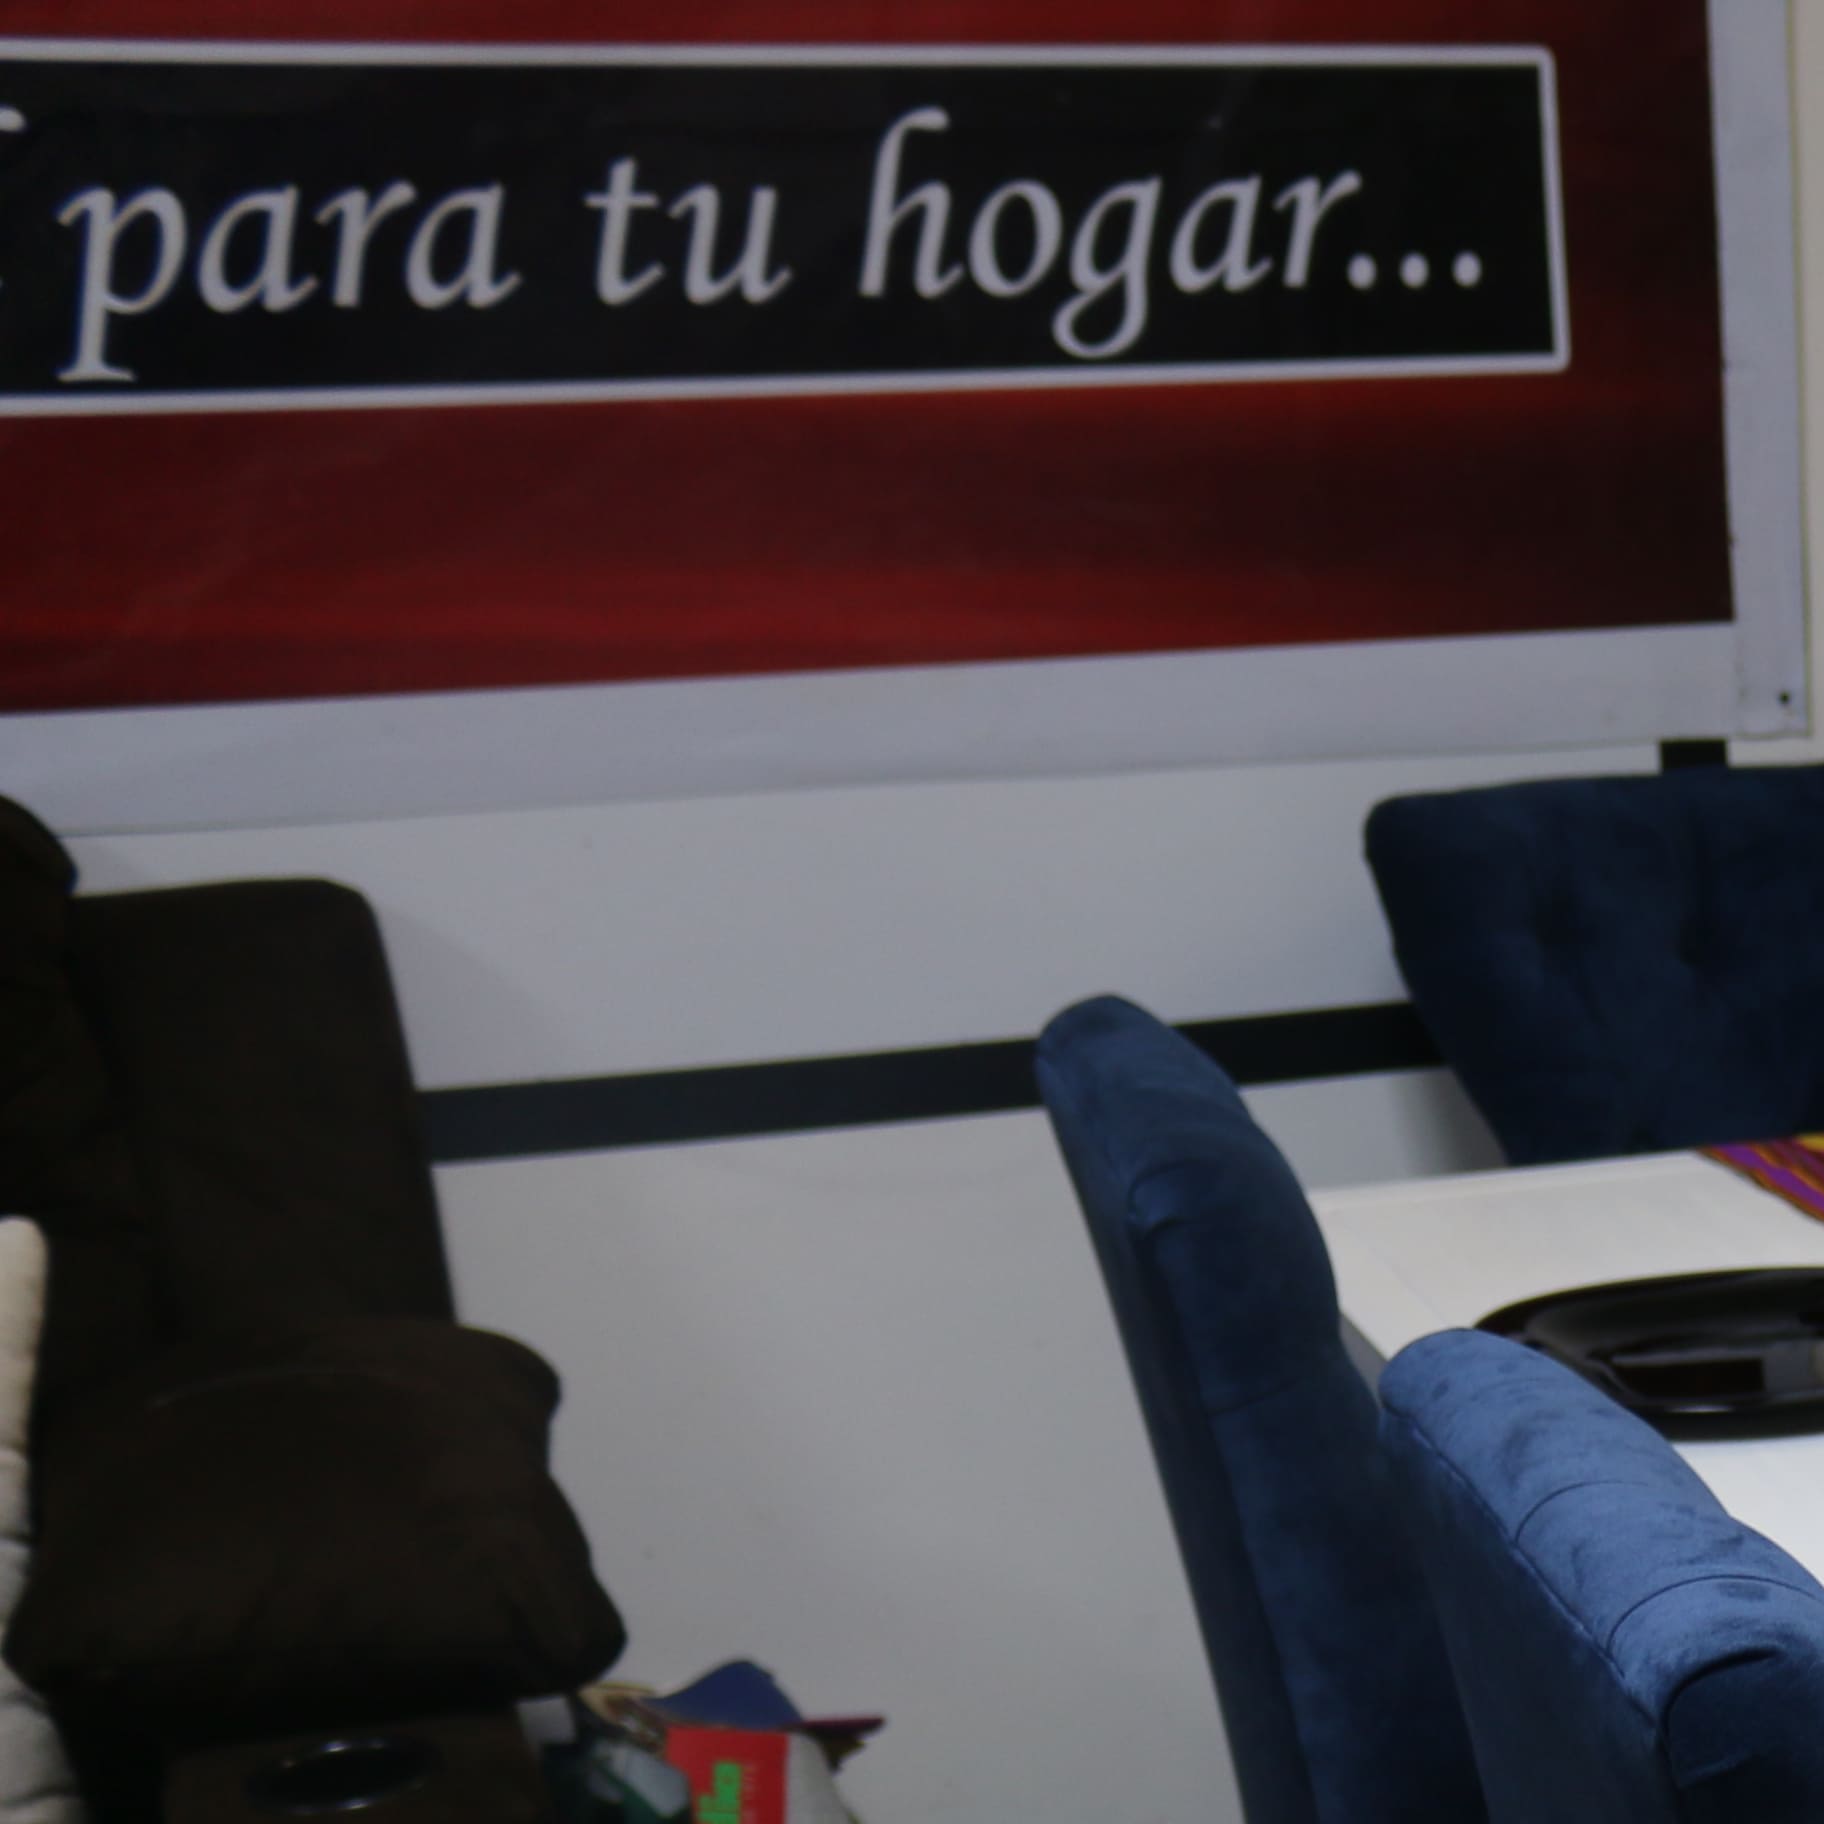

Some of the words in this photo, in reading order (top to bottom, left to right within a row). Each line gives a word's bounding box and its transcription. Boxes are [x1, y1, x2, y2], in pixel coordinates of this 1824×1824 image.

[59, 182, 519, 382] para
[586, 159, 790, 306] tu
[860, 107, 1482, 359] hogar...
